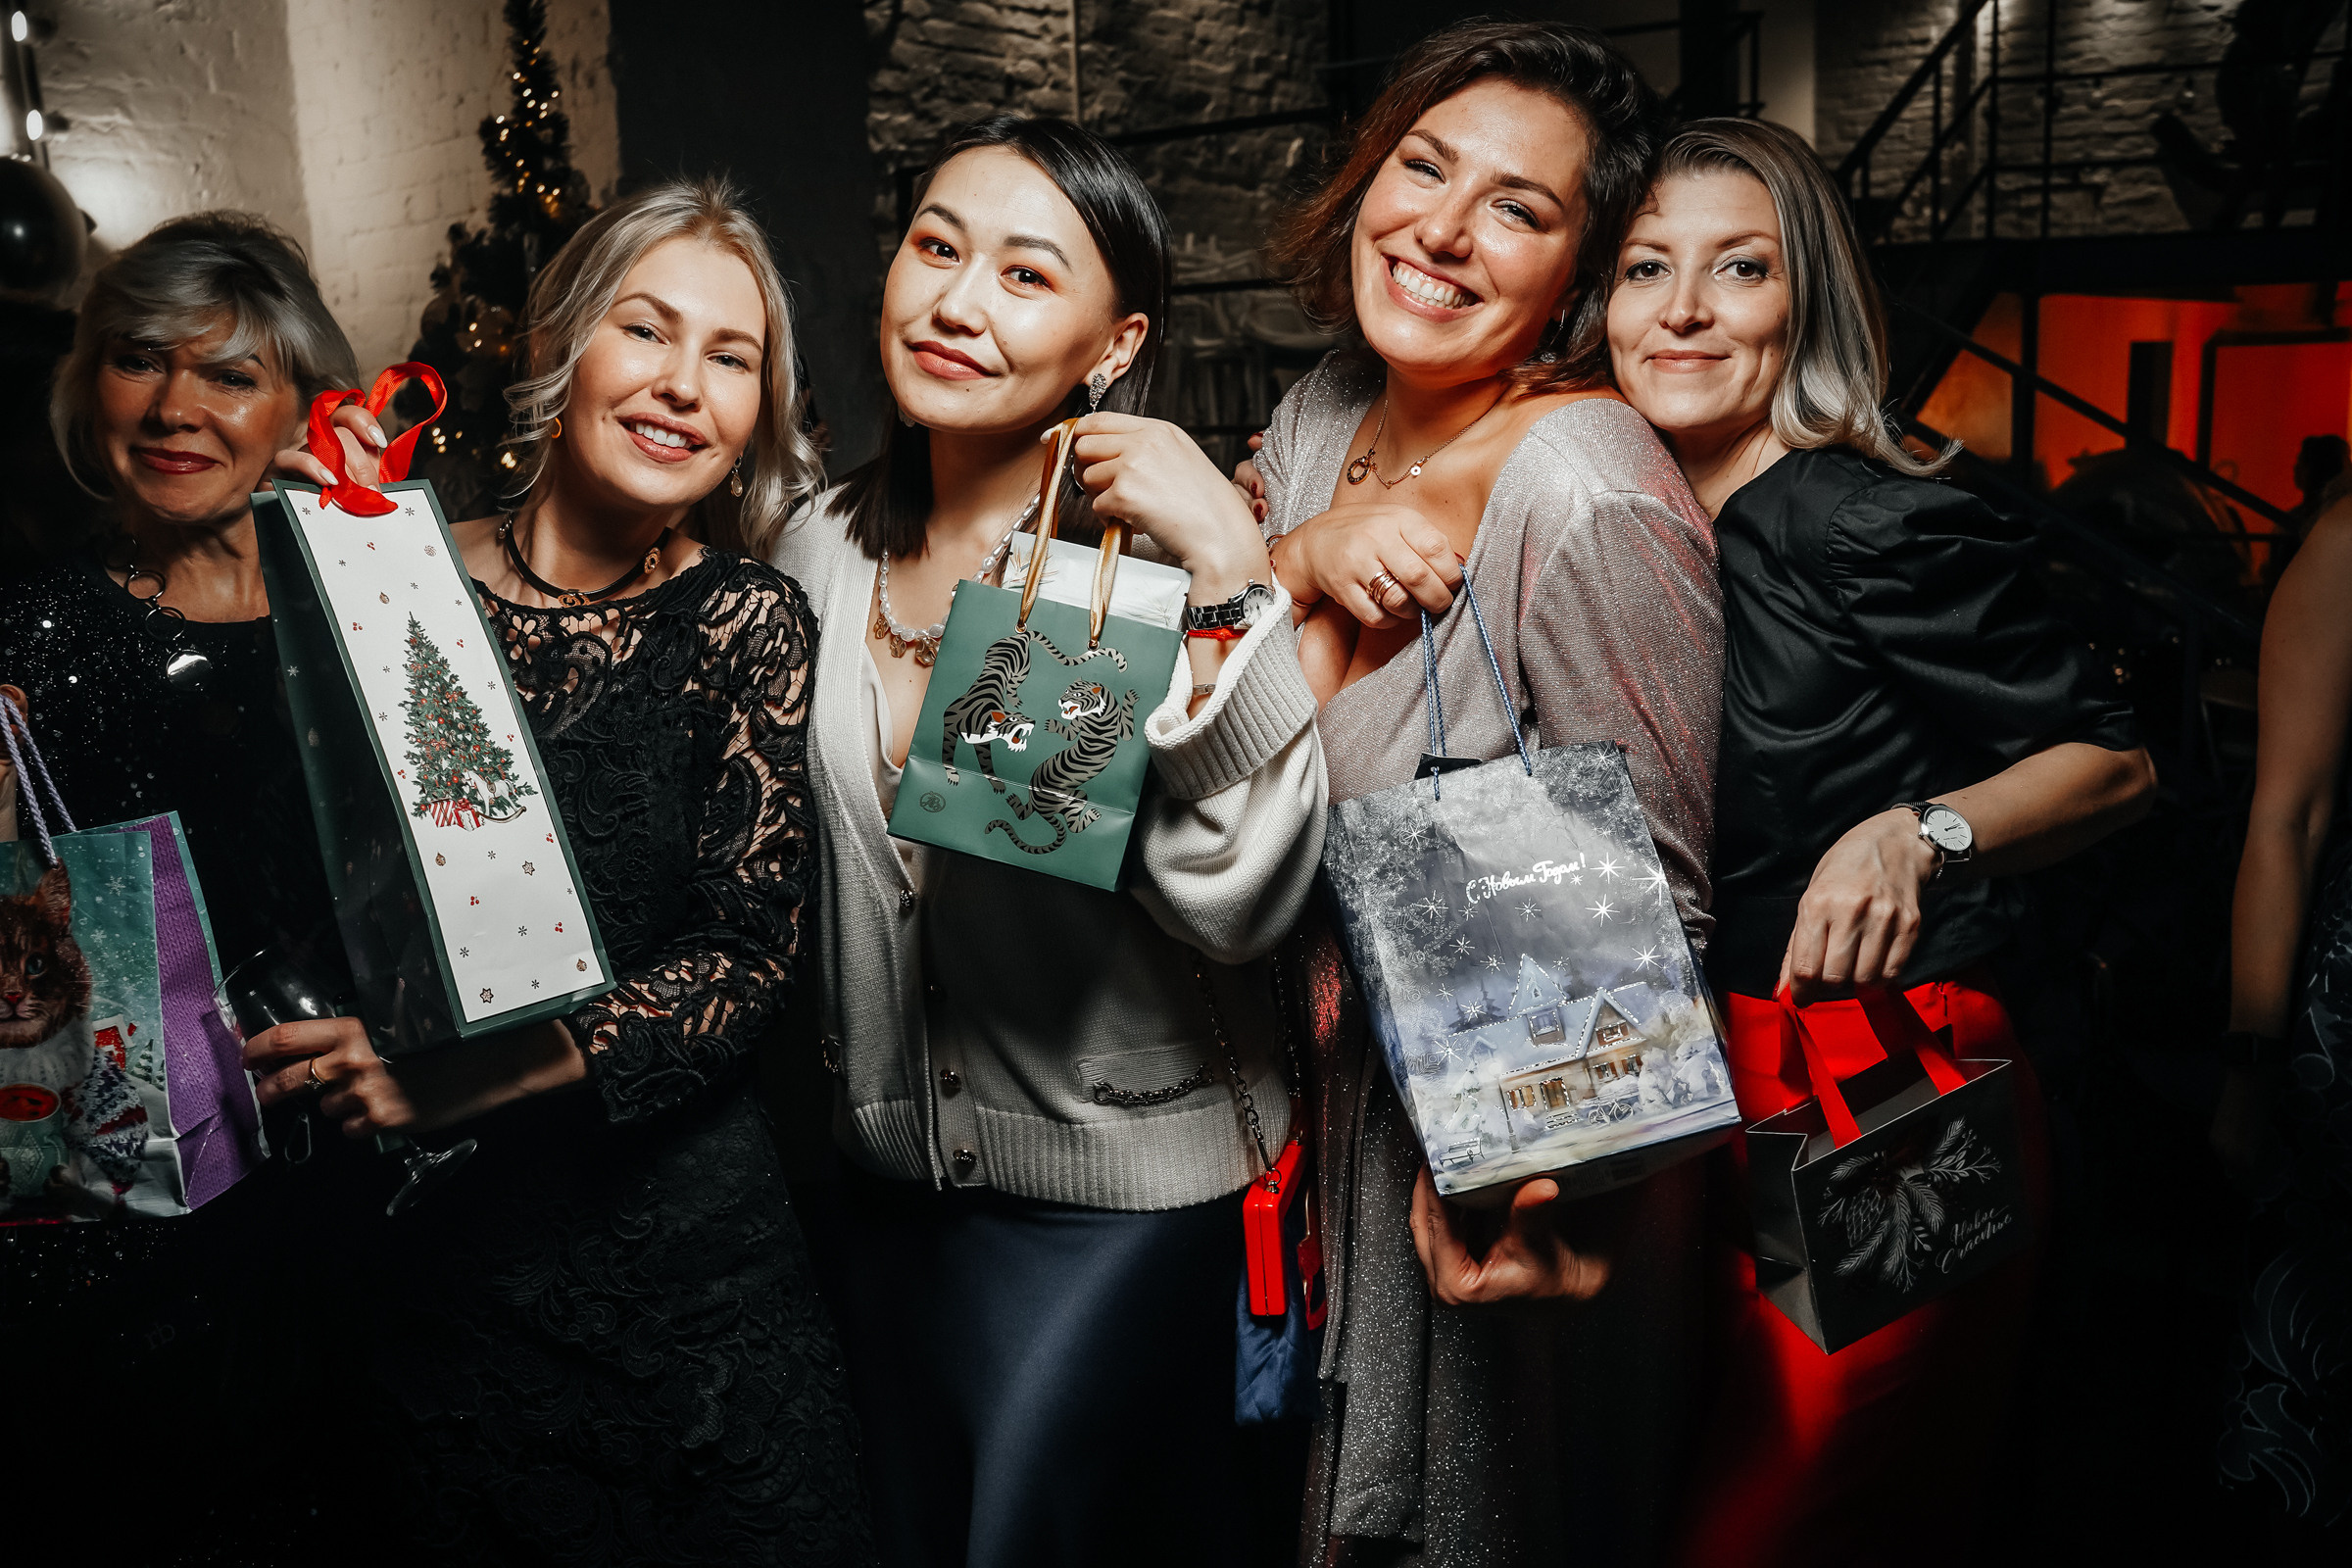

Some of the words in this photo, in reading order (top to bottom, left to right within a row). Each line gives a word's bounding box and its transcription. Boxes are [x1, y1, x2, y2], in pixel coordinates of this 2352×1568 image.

[1466, 879, 1481, 904] С
[1478, 870, 1536, 899] Новом
[1532, 852, 1587, 885] Годом!
